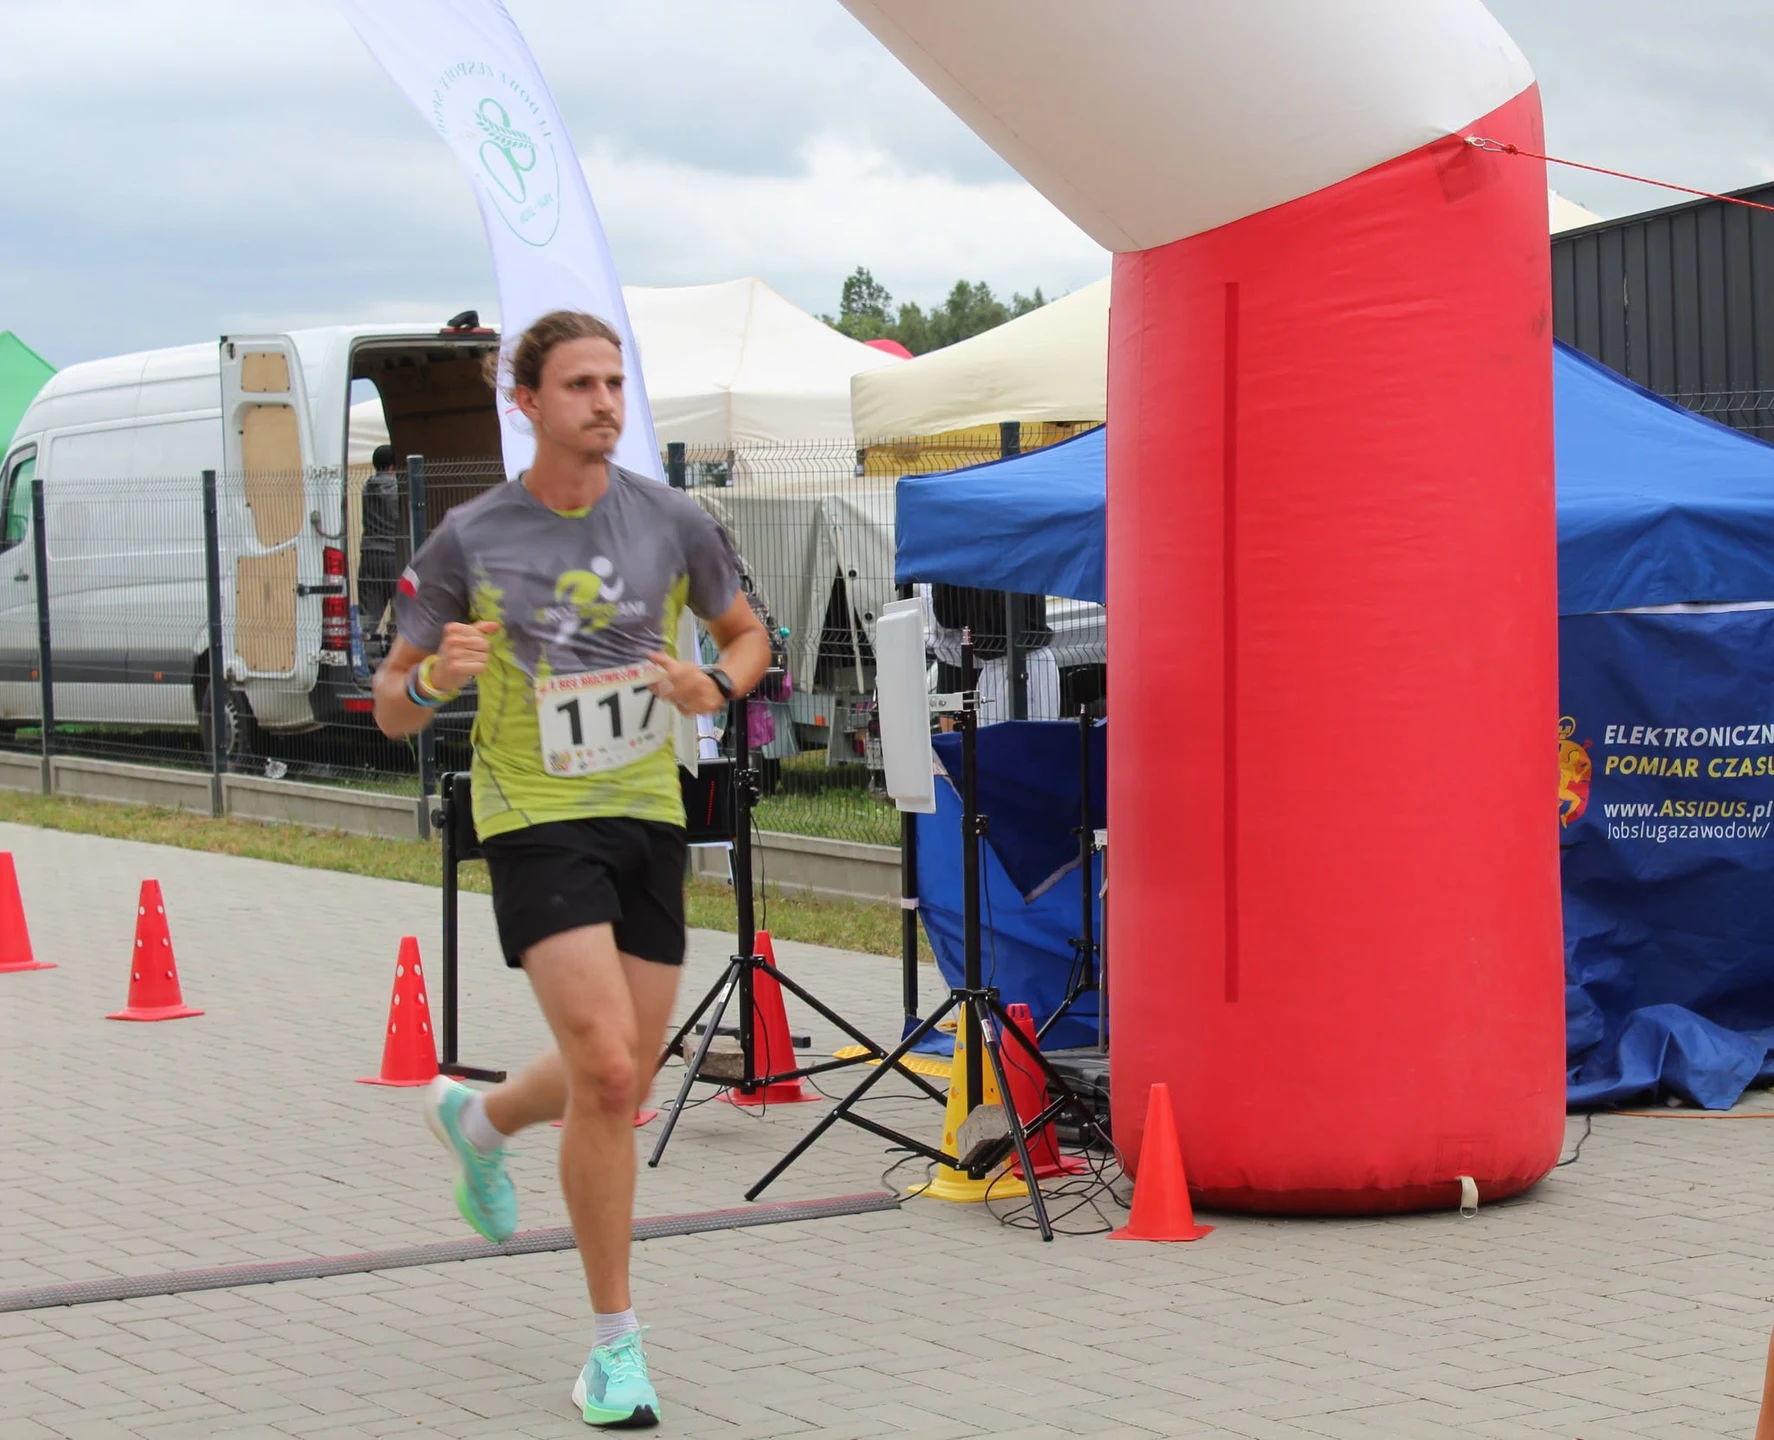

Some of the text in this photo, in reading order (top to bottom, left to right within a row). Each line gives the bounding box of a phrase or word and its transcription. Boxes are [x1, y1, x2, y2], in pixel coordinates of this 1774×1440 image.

[557, 685, 657, 746] 117
[1604, 724, 1774, 747] ELEKTRONICZN
[1605, 756, 1699, 778] POMIAR
[1604, 799, 1773, 822] www.ASSIDUS.pl
